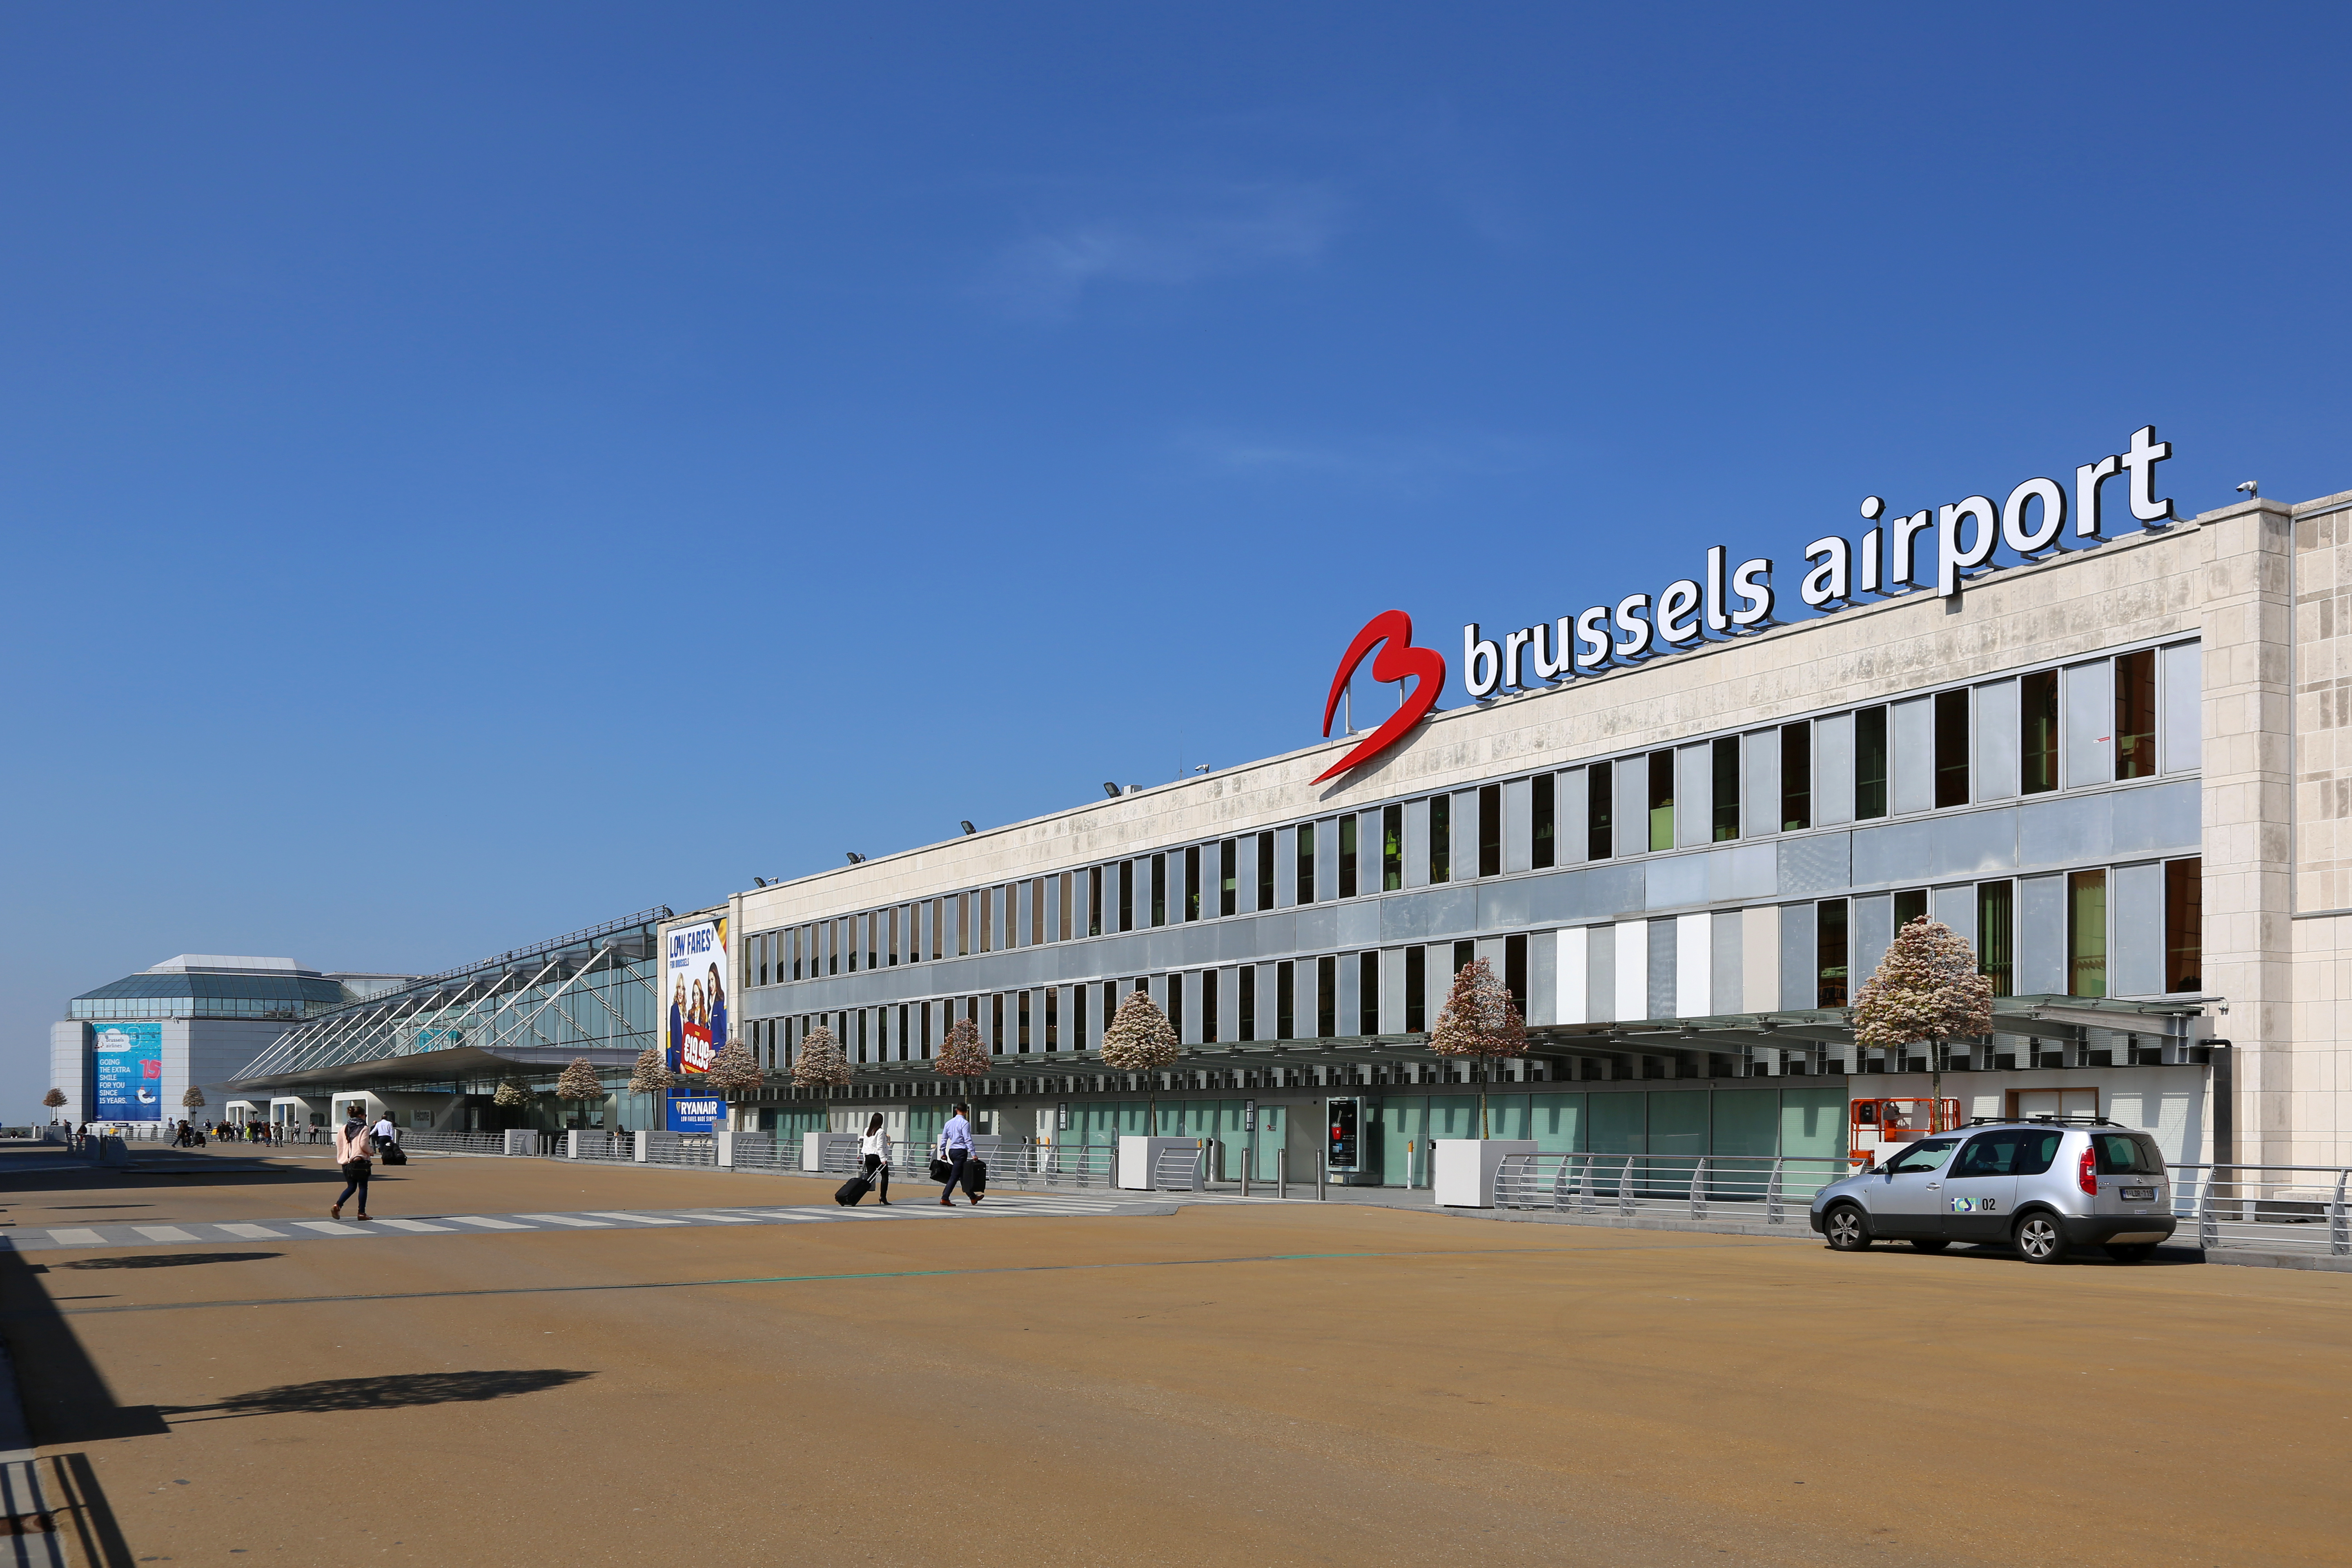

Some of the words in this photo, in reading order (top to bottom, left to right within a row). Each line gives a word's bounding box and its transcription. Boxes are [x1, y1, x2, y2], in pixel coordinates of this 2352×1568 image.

[1464, 546, 1773, 697] brussels
[1801, 425, 2172, 606] airport
[670, 934, 686, 958] LOW
[688, 929, 710, 955] FARES
[684, 1033, 709, 1070] €19.99
[139, 1059, 162, 1080] 15
[681, 1101, 717, 1115] RYANAIR
[1982, 1198, 1996, 1210] 02
